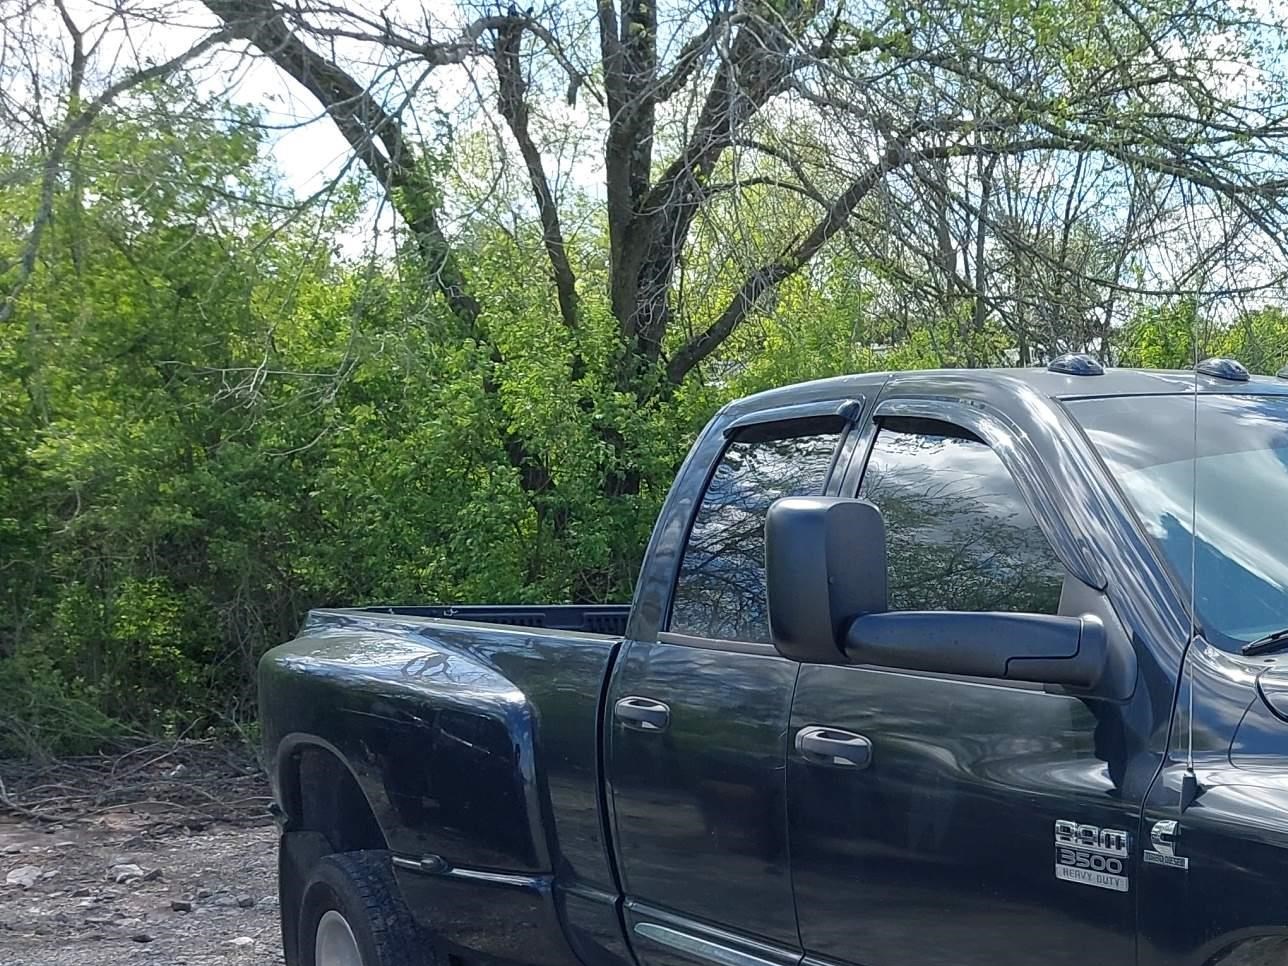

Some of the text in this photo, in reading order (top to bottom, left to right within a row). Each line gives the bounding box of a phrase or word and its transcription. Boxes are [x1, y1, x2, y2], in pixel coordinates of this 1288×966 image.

[1055, 819, 1128, 856] RAM
[1059, 848, 1123, 874] 3500
[1062, 867, 1121, 886] HEAVY DUTY
